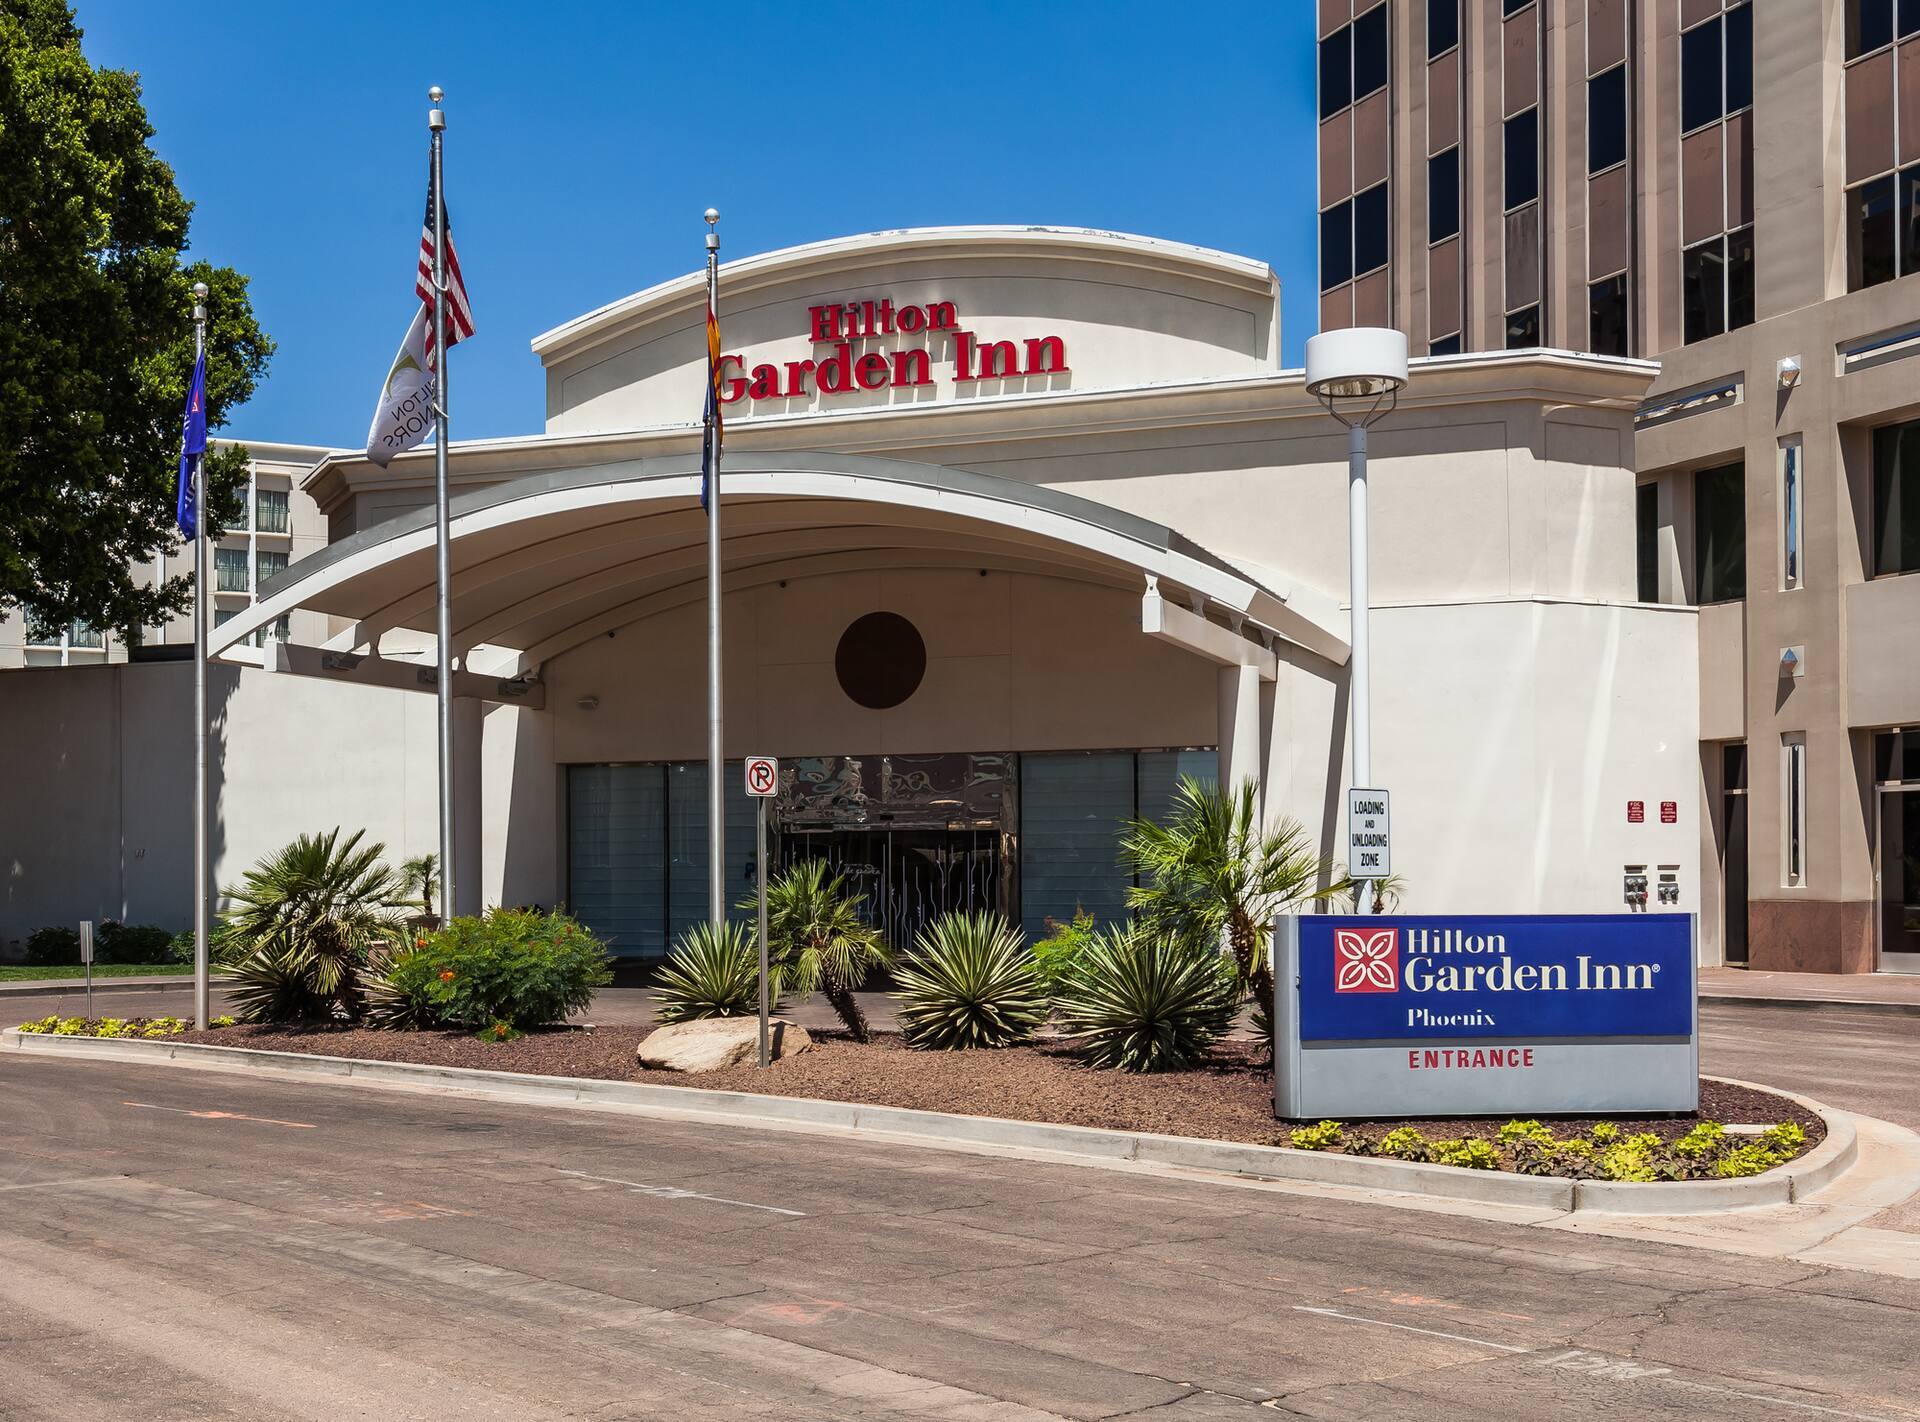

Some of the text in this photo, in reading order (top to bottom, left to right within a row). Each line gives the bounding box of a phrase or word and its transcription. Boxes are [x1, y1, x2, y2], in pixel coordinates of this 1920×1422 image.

[808, 298, 958, 343] Hilton
[720, 331, 1071, 403] Garden Inn
[1354, 800, 1384, 815] LOADING
[1365, 819, 1375, 829] AND
[1352, 833, 1387, 847] UNLOADING
[1360, 853, 1380, 867] ZONE
[1404, 956, 1569, 992] Garden
[1408, 1008, 1496, 1026] Phoenix
[1409, 1049, 1534, 1069] ENTRANCE
